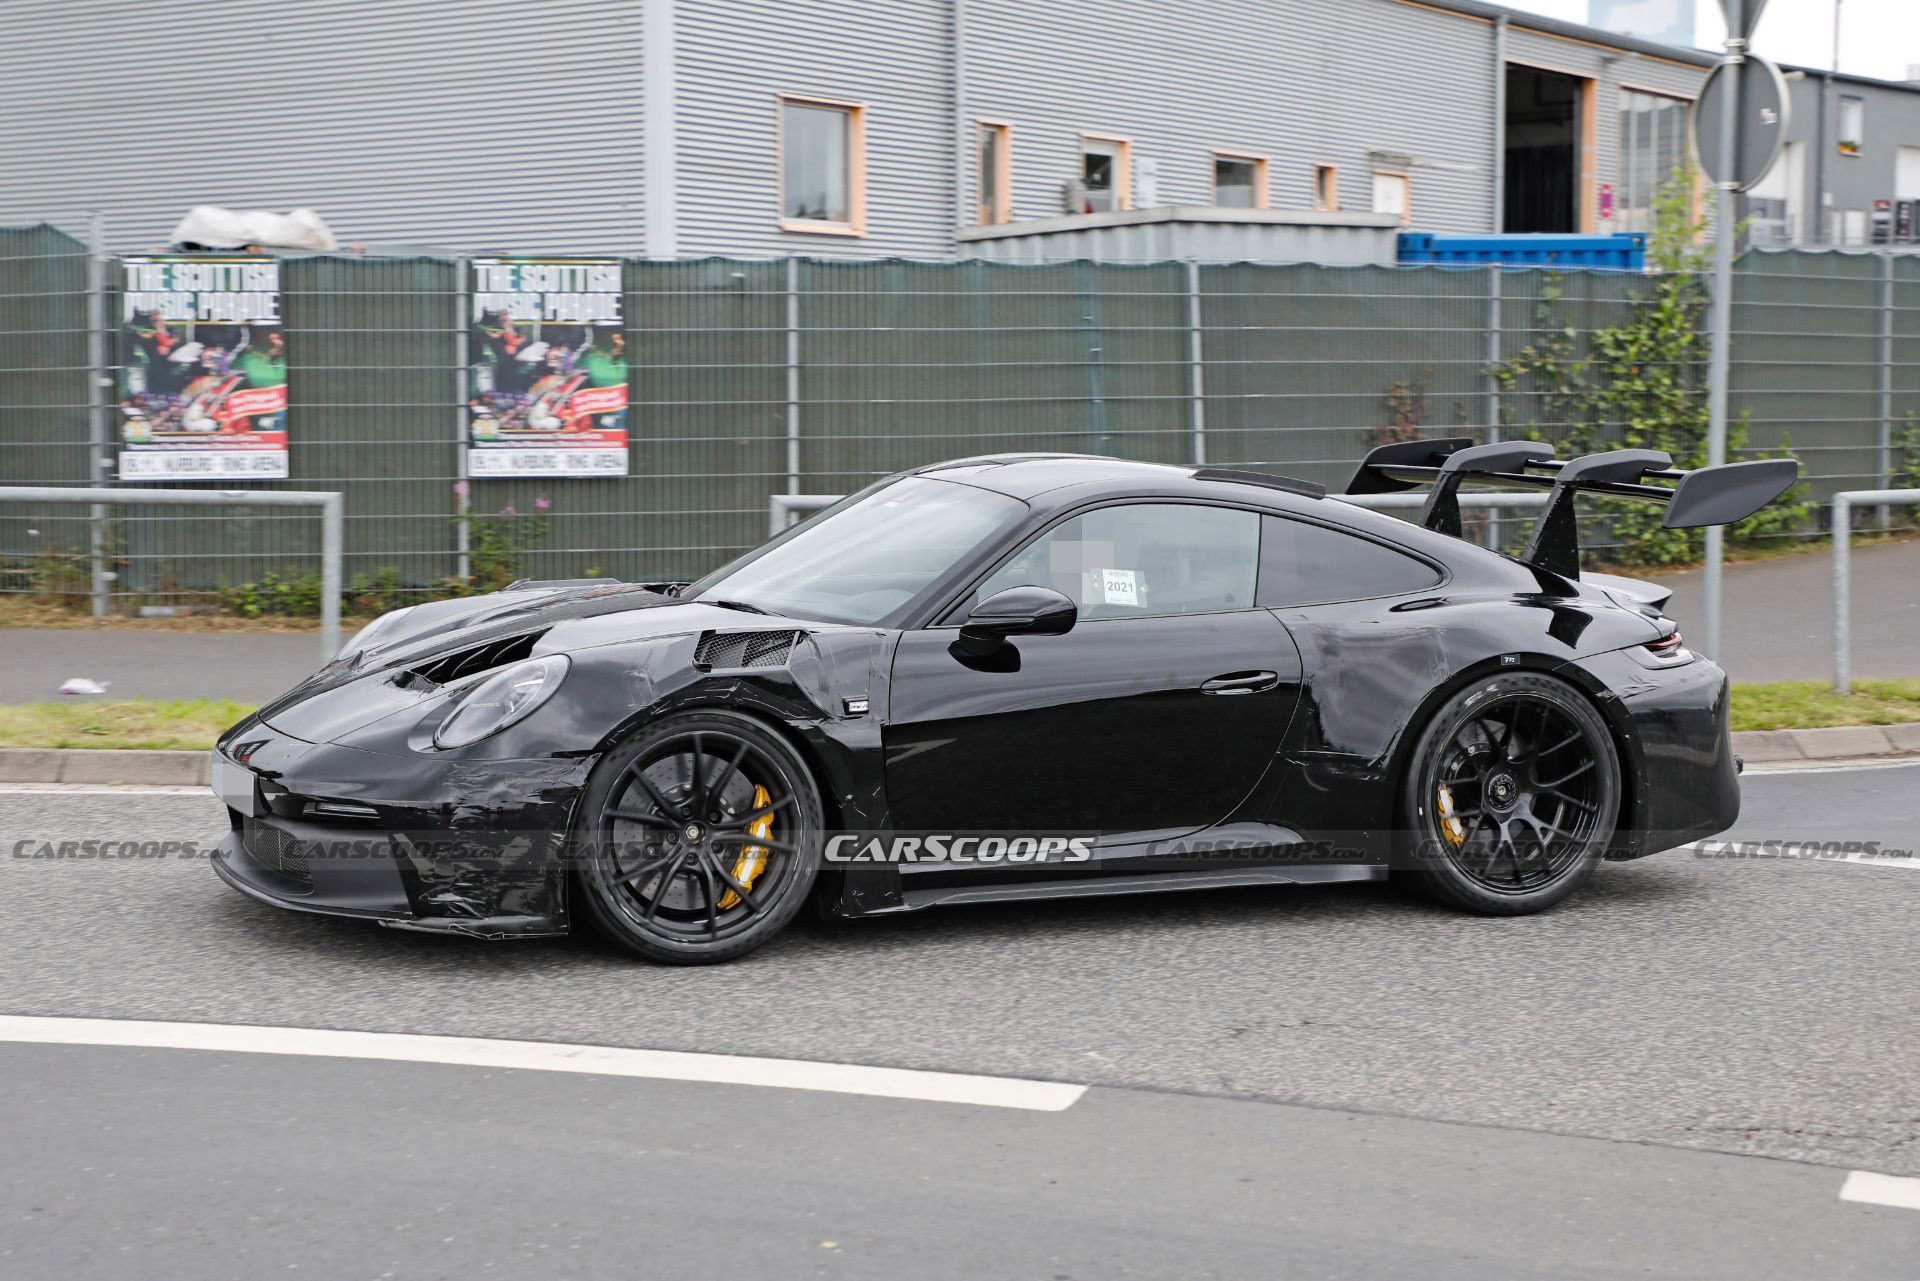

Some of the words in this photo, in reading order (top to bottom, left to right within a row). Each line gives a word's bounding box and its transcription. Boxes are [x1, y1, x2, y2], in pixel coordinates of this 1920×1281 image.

[122, 264, 170, 291] THE
[171, 264, 280, 291] SCOTTISH
[472, 265, 518, 292] THE
[519, 265, 623, 292] SCOTTISH
[197, 292, 281, 321] PARADE
[543, 293, 624, 321] PARADE
[1107, 581, 1133, 592] 2021
